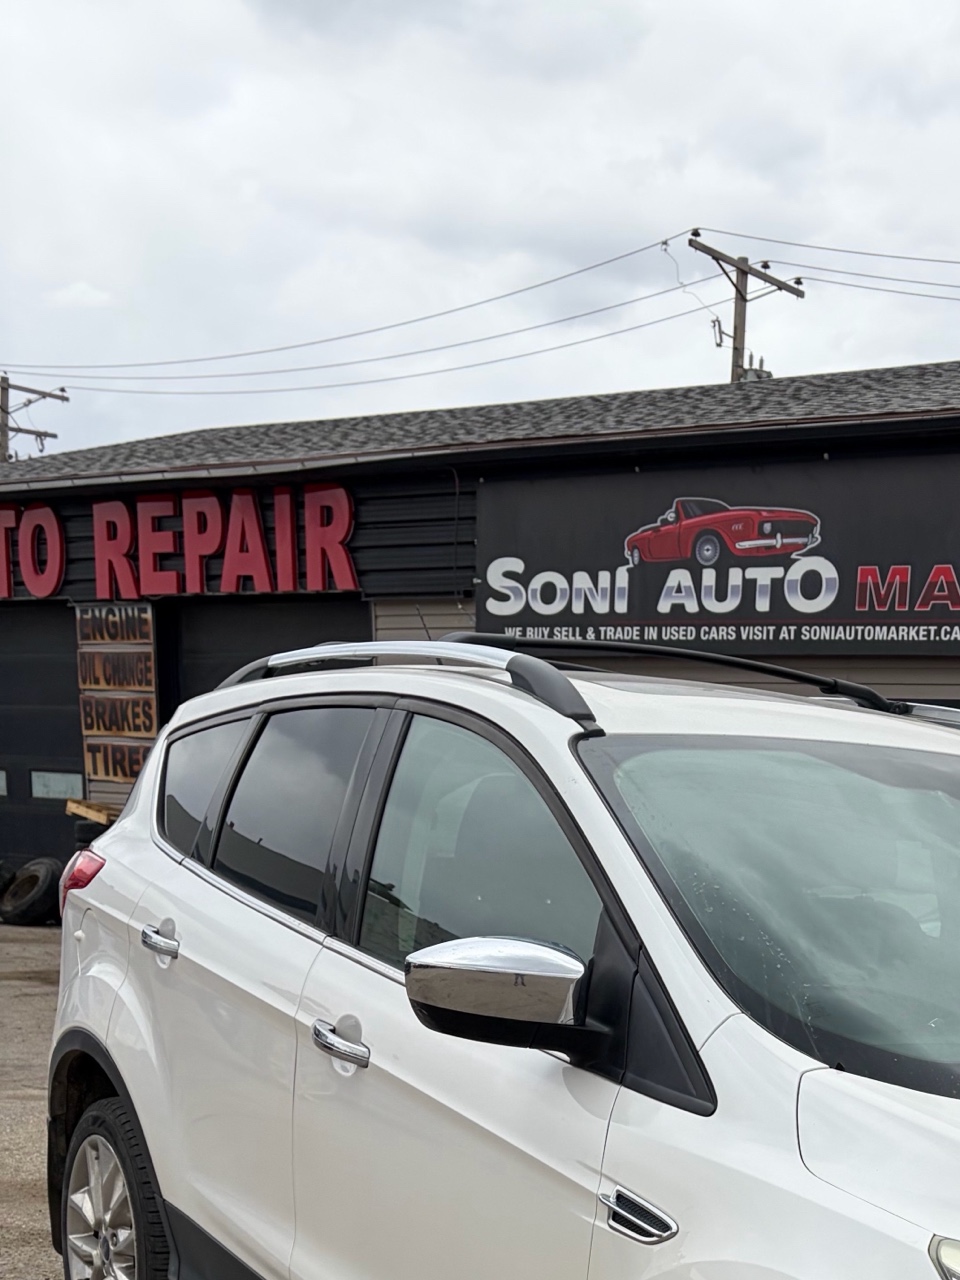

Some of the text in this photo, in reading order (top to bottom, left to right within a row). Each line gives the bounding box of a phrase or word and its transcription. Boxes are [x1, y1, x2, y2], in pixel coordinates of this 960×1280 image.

[92, 483, 360, 600] REPAIR
[485, 556, 631, 616] SONI
[656, 556, 840, 614] AUTO
[78, 606, 150, 641] ENGINE
[504, 627, 525, 640] WE
[526, 627, 552, 641] BUY
[553, 626, 583, 641] SELL
[585, 627, 596, 641] &
[599, 626, 641, 641] TRADE
[644, 626, 658, 641] IN
[661, 626, 697, 641] USED
[700, 626, 737, 641] CARS
[740, 626, 776, 641] VISIT
[779, 626, 797, 641] AT
[80, 651, 152, 687] OIL CHANGE
[83, 700, 154, 733] BRAKES
